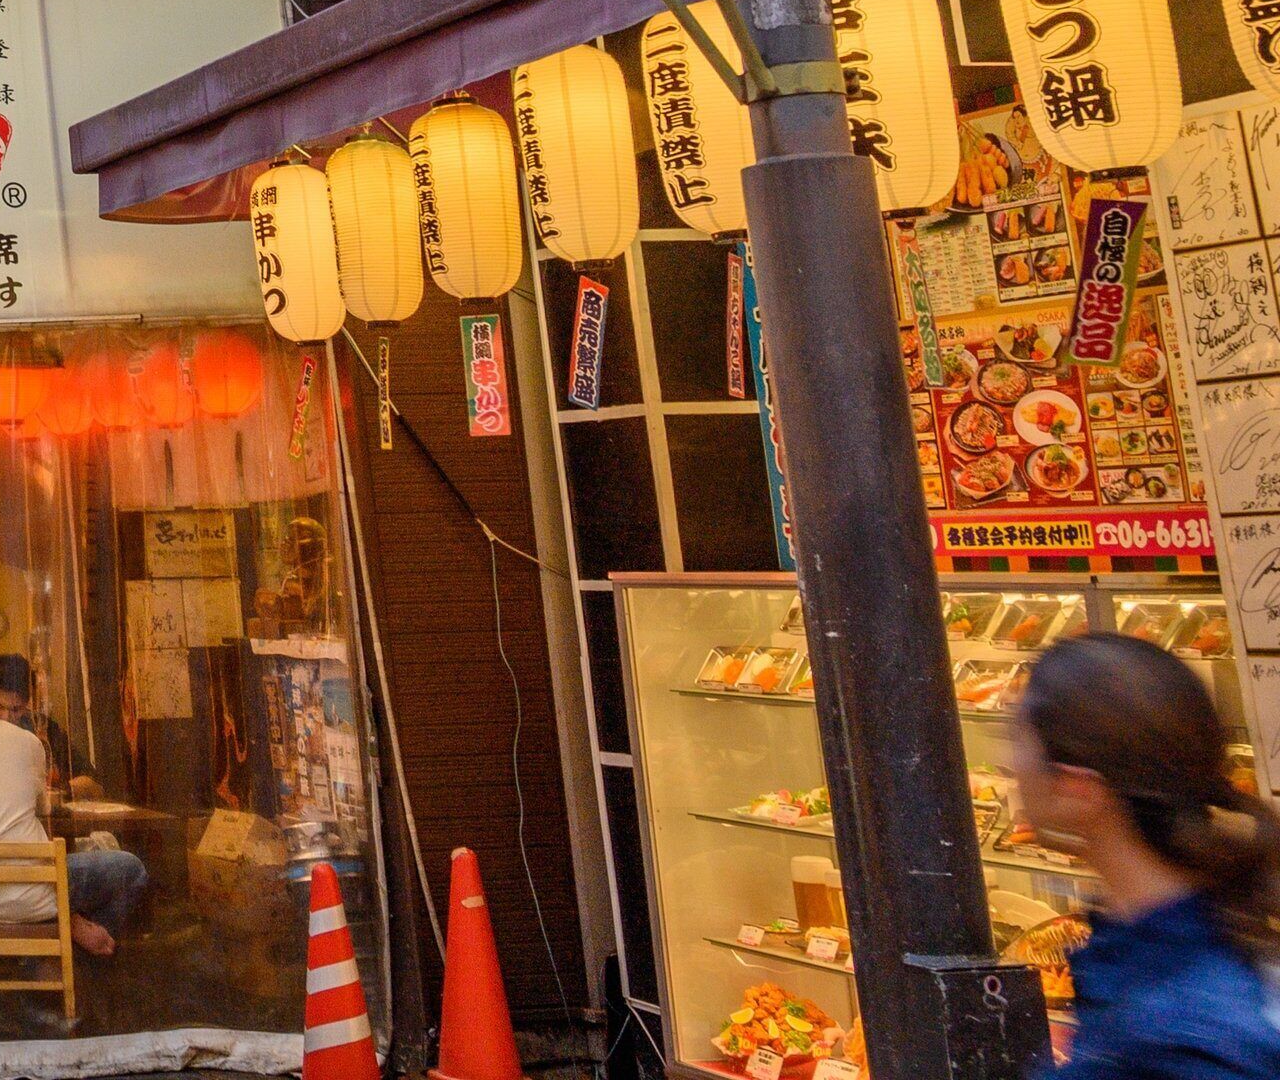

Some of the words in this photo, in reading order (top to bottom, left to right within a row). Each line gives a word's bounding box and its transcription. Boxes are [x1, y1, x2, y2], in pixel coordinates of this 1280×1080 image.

[644, 23, 717, 211] 二度漬禁止
[253, 211, 288, 317] 串かつ
[1071, 207, 1131, 362] 自慢の逸品
[471, 323, 493, 360] 横綱
[573, 287, 604, 407] 商売繁盛
[471, 359, 503, 434] 串かつ
[947, 523, 1092, 549] 各種宴会予約受付中!!
